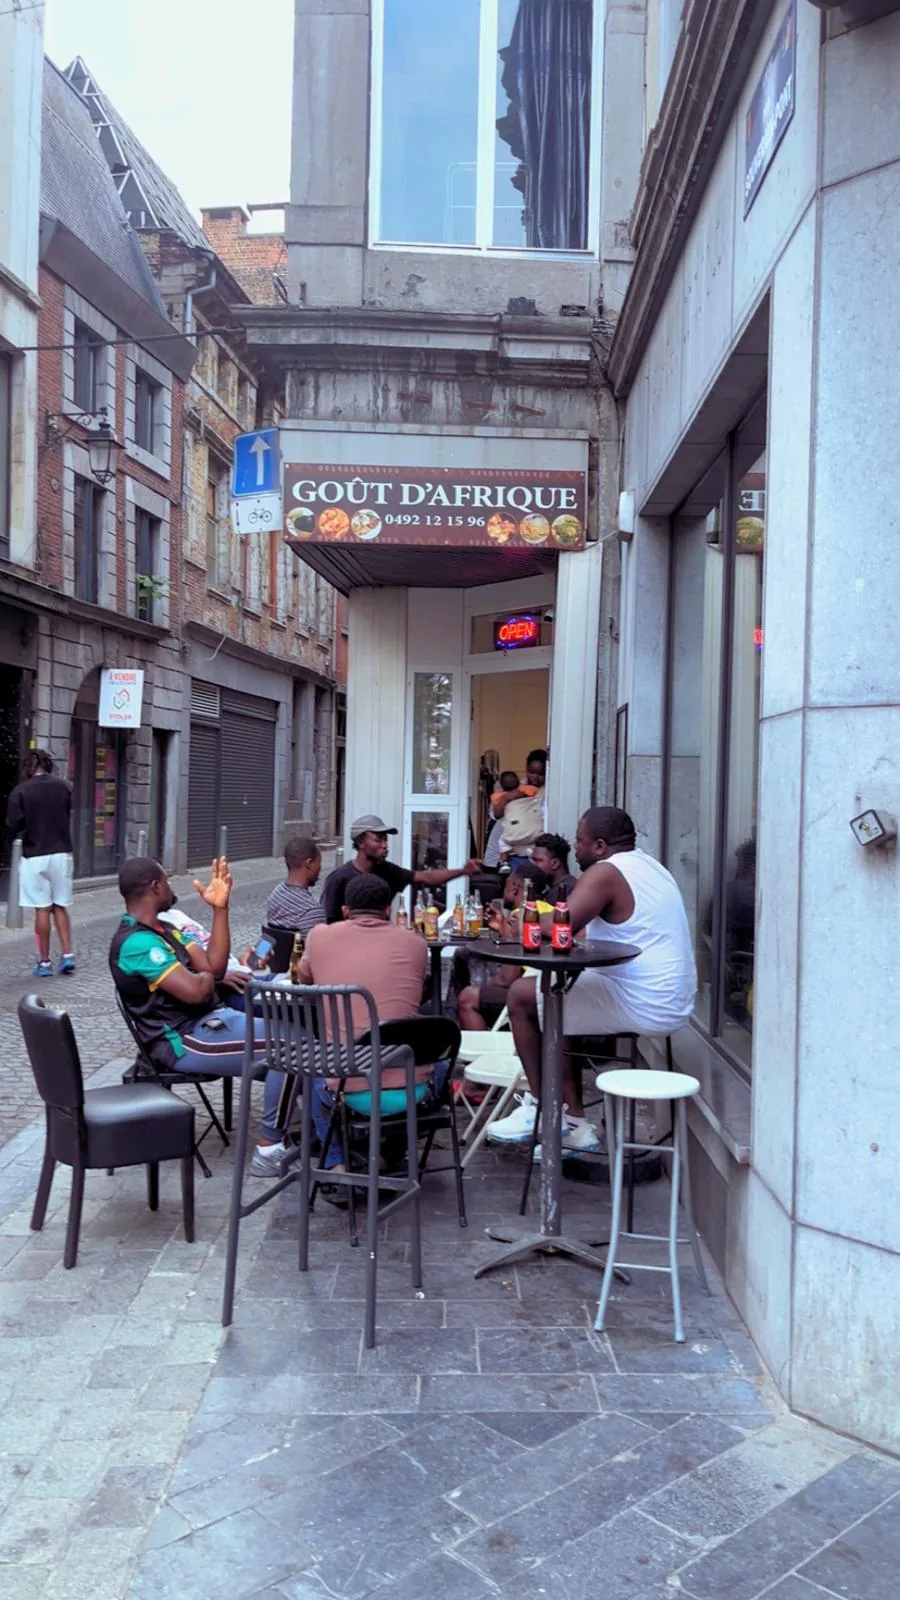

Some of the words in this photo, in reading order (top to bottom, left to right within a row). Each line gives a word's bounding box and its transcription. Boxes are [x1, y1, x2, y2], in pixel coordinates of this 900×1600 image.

[292, 476, 393, 504] GOÛT
[399, 482, 578, 513] D'AFRIQUE
[385, 513, 420, 525] 0492
[425, 516, 442, 526] 12
[447, 516, 464, 526] 15
[467, 516, 486, 527] 96
[499, 621, 534, 640] OPEN
